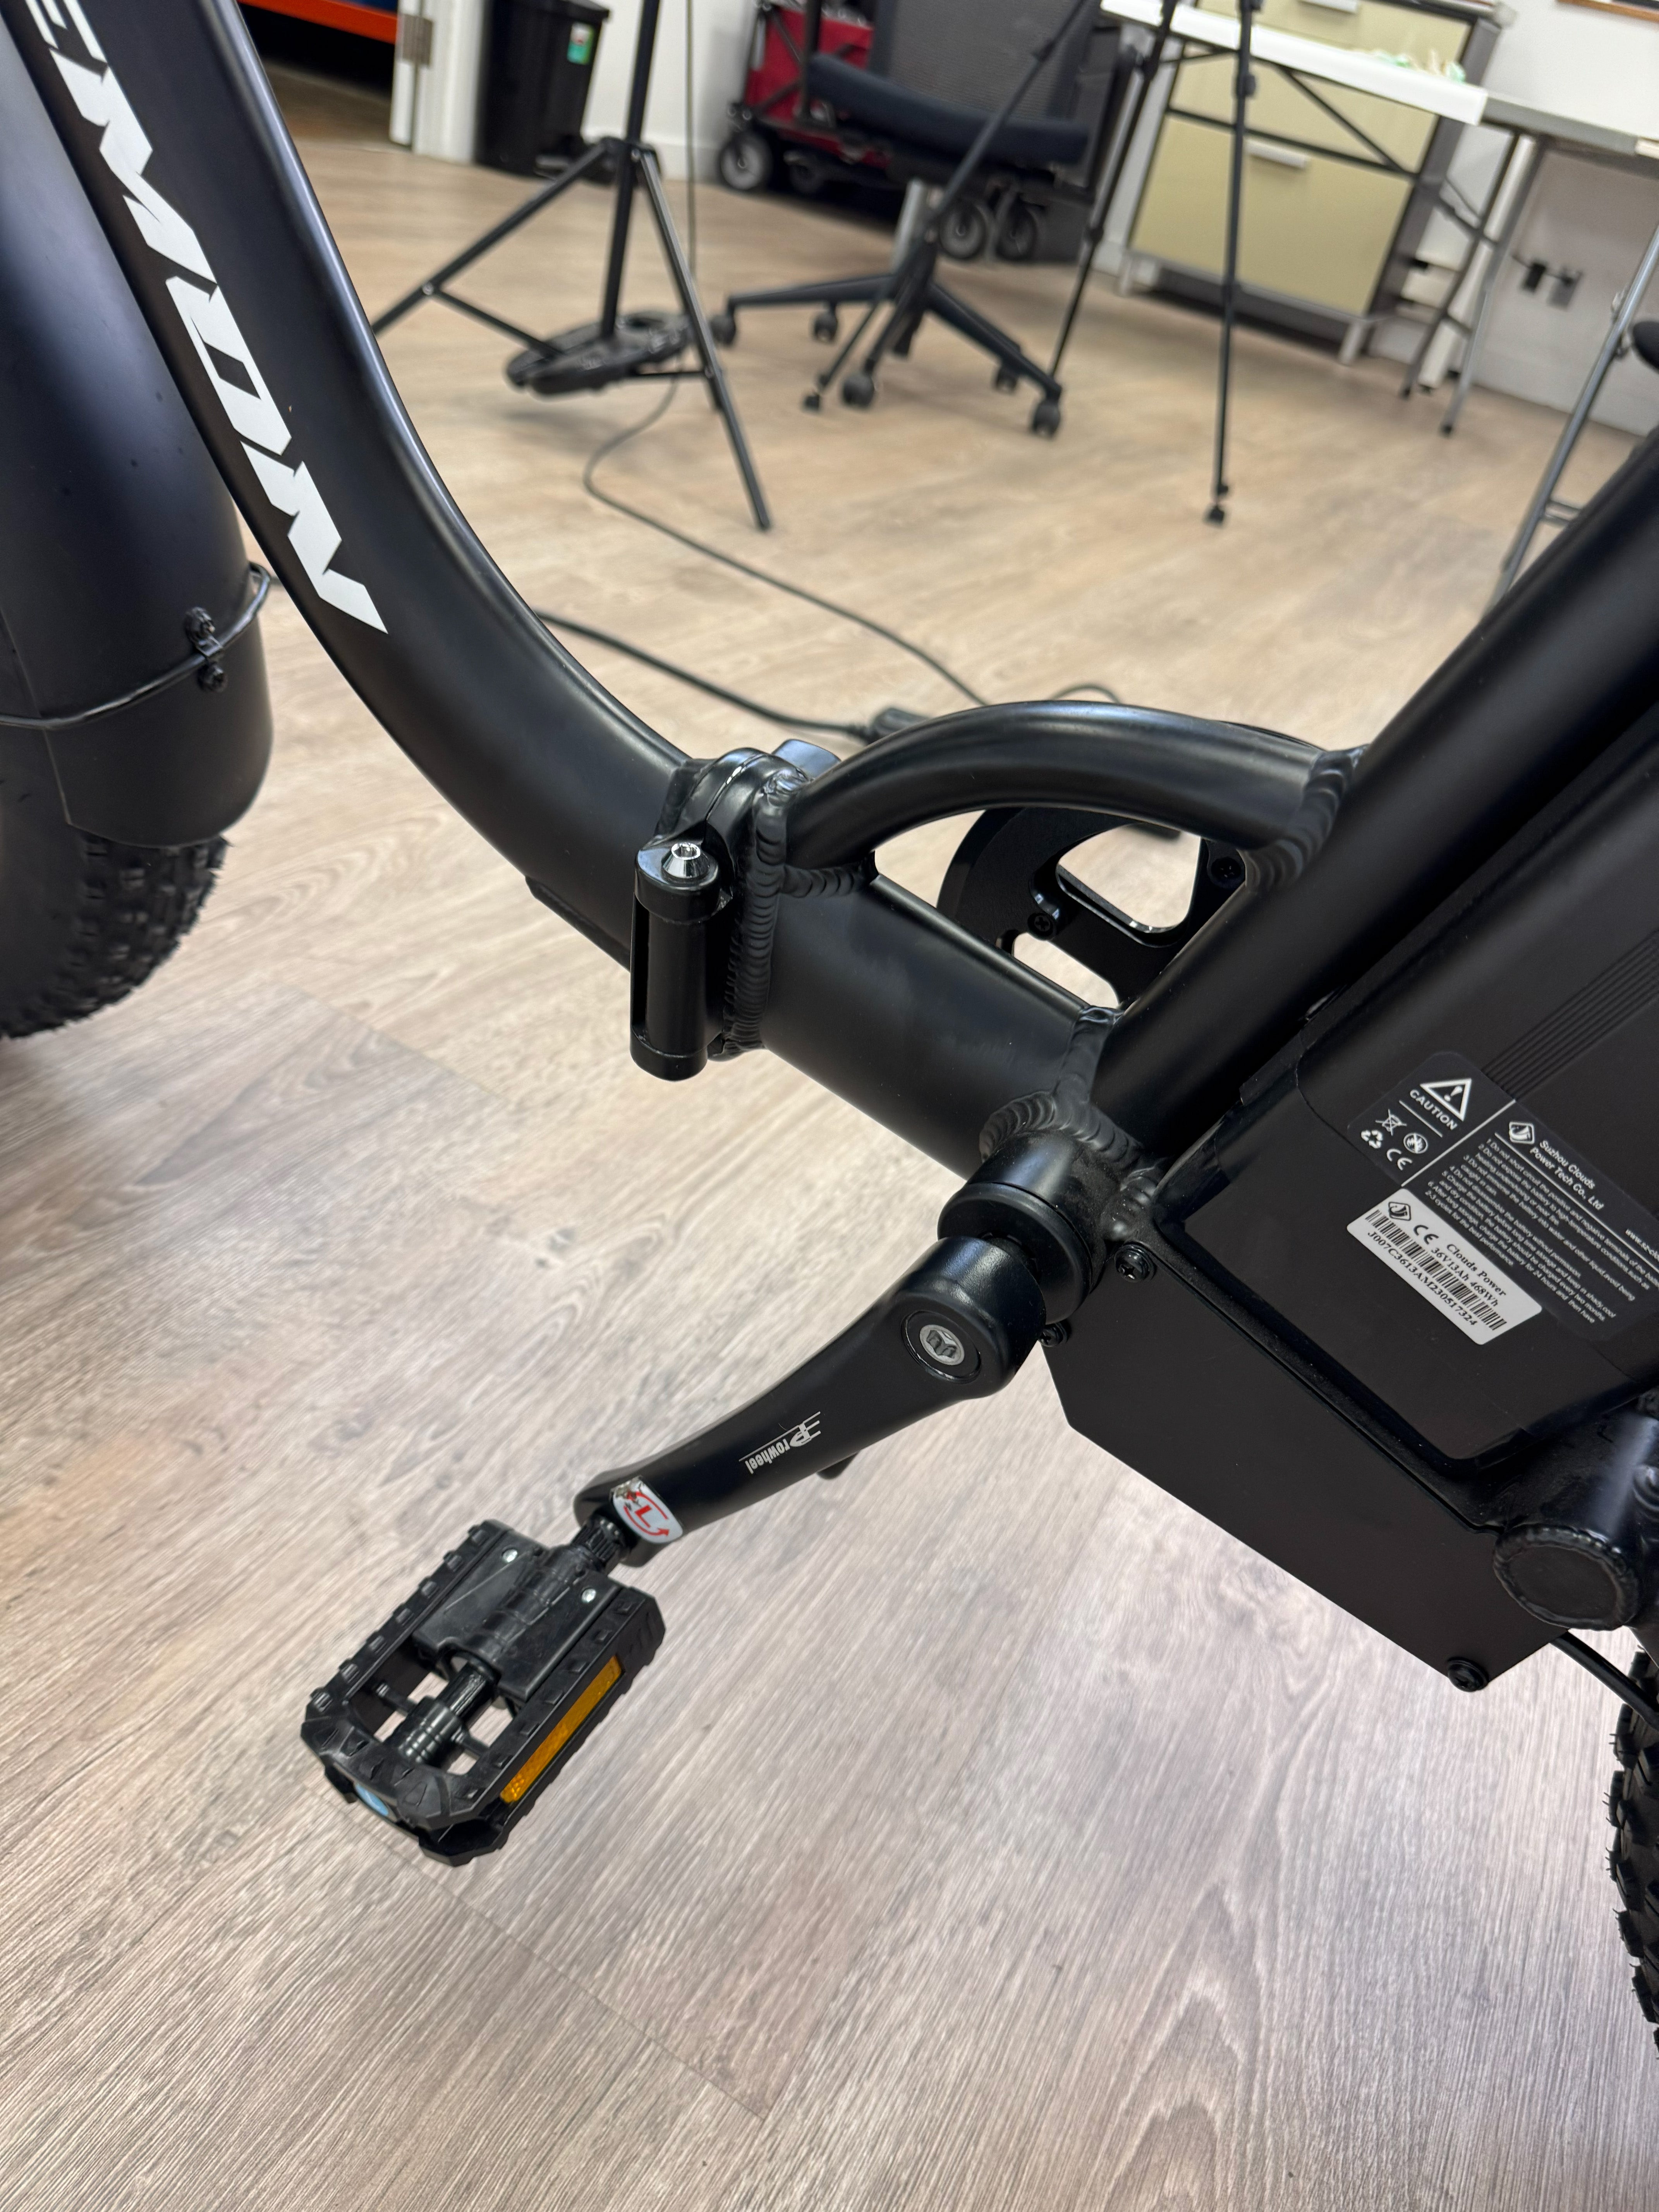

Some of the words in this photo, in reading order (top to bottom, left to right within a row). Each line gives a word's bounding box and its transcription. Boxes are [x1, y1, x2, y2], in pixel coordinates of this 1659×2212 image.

[1409, 1089, 1458, 1130] CAUTION
[1385, 1147, 1412, 1170] CE
[1460, 1164, 1480, 1181] caught
[1529, 1147, 1555, 1169] Power
[1554, 1167, 1574, 1185] Tech
[1587, 1196, 1604, 1210] Ltd
[1539, 1140, 1569, 1166] Suzhou
[1567, 1164, 1596, 1189] Clouds
[1424, 1190, 1436, 1200] 2-3
[1434, 1198, 1452, 1214] cycles
[1451, 1212, 1461, 1220] for
[1459, 1219, 1470, 1228] the
[1468, 1226, 1482, 1238] best
[1462, 1176, 1473, 1186] not
[1471, 1185, 1505, 1213] disassemble
[1504, 1212, 1515, 1221] the
[1513, 1219, 1533, 1237] battery
[1532, 1235, 1553, 1254] without
[1491, 1155, 1503, 1165] not
[1501, 1164, 1522, 1182] expose
[1520, 1180, 1532, 1190] the
[1530, 1188, 1551, 1206] battery
[1555, 1209, 1601, 1249] high-temperature
[1498, 1150, 1510, 1159] not
[1508, 1158, 1524, 1171] short
[1522, 1170, 1541, 1186] circuit
[1539, 1183, 1550, 1193] the
[1547, 1192, 1571, 1211] positive
[1569, 1210, 1583, 1221] and
[1580, 1219, 1605, 1240] negative
[1604, 1238, 1630, 1261] terminals
[1635, 1264, 1646, 1274] the
[1535, 1204, 1550, 1217] near
[1439, 1180, 1452, 1191] and
[1449, 1189, 1460, 1198] dry
[1484, 1218, 1495, 1227] the
[1493, 1225, 1513, 1243] battery
[1512, 1242, 1532, 1258] should
[1537, 1263, 1561, 1283] charged
[1559, 1281, 1575, 1295] every
[1574, 1294, 1585, 1304] two
[1445, 1196, 1459, 1209] long
[1479, 1225, 1498, 1242] charge
[1497, 1240, 1508, 1249] the
[1506, 1248, 1526, 1265] battery
[1525, 1263, 1534, 1271] for
[1540, 1276, 1557, 1291] hours
[1555, 1290, 1568, 1300] and
[1568, 1300, 1582, 1312] then
[1580, 1310, 1595, 1323] have
[1466, 1191, 1477, 1200] the
[1475, 1199, 1495, 1216] battery
[1493, 1214, 1512, 1231] before
[1511, 1229, 1525, 1242] long
[1523, 1239, 1537, 1251] time
[1535, 1250, 1556, 1268] storage
[1555, 1267, 1568, 1278] and
[1566, 1276, 1581, 1289] keep
[1476, 1166, 1488, 1176] not
[1486, 1174, 1510, 1195] immerse
[1509, 1193, 1520, 1203] the
[1518, 1201, 1539, 1219] battery
[1537, 1217, 1549, 1228] into
[1548, 1226, 1565, 1240] water
[1563, 1240, 1577, 1250] and
[1574, 1249, 1590, 1262] other
[1618, 1285, 1635, 1301] being
[1430, 1247, 1470, 1281] 36V13Ah
[1469, 1281, 1499, 1307] 468Wh
[1446, 1243, 1478, 1272] Clouds
[1477, 1270, 1507, 1296] Power
[745, 1411, 821, 1474] Prowheel
[634, 1504, 652, 1528] L
